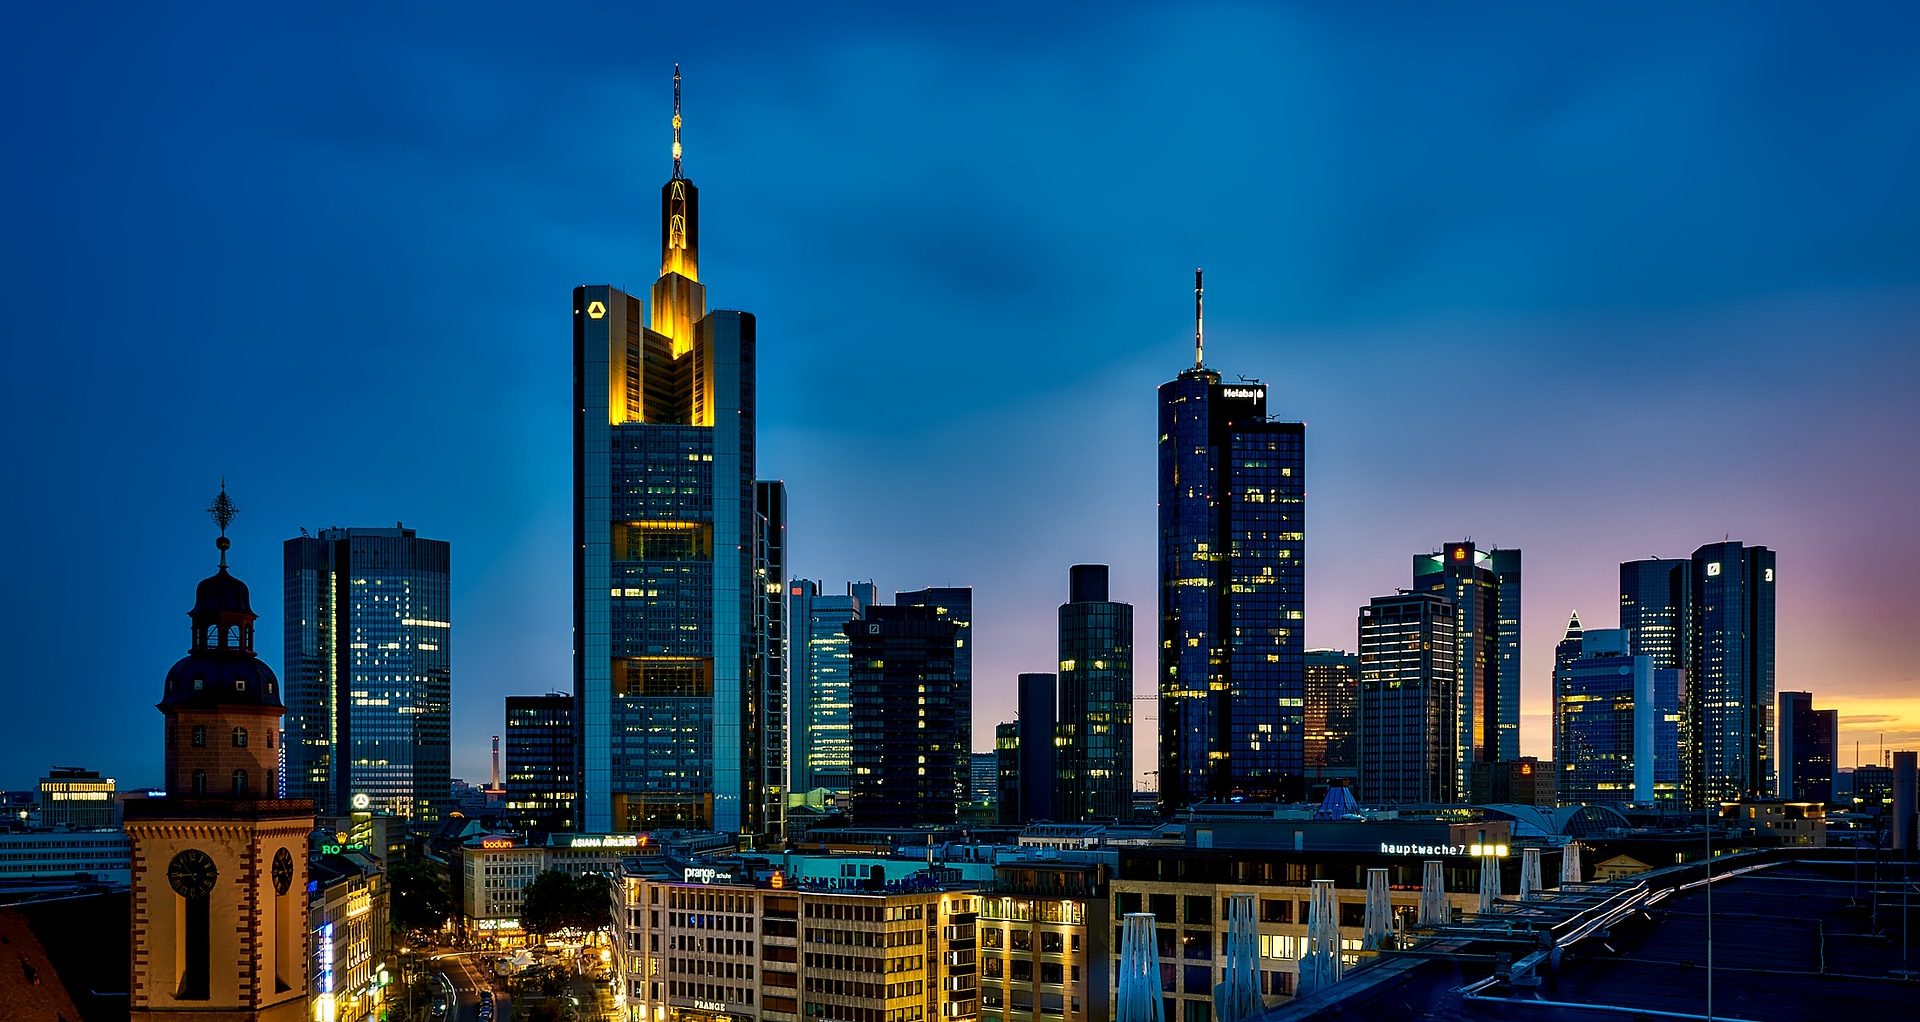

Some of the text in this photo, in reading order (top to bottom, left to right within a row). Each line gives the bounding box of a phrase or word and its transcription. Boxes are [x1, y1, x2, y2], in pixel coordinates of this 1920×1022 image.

[1224, 388, 1253, 398] Helaba
[483, 840, 512, 849] bodum
[571, 837, 637, 848] ASIANA AIRLINES
[684, 867, 715, 884] prange
[694, 1000, 726, 1012] PRANGE
